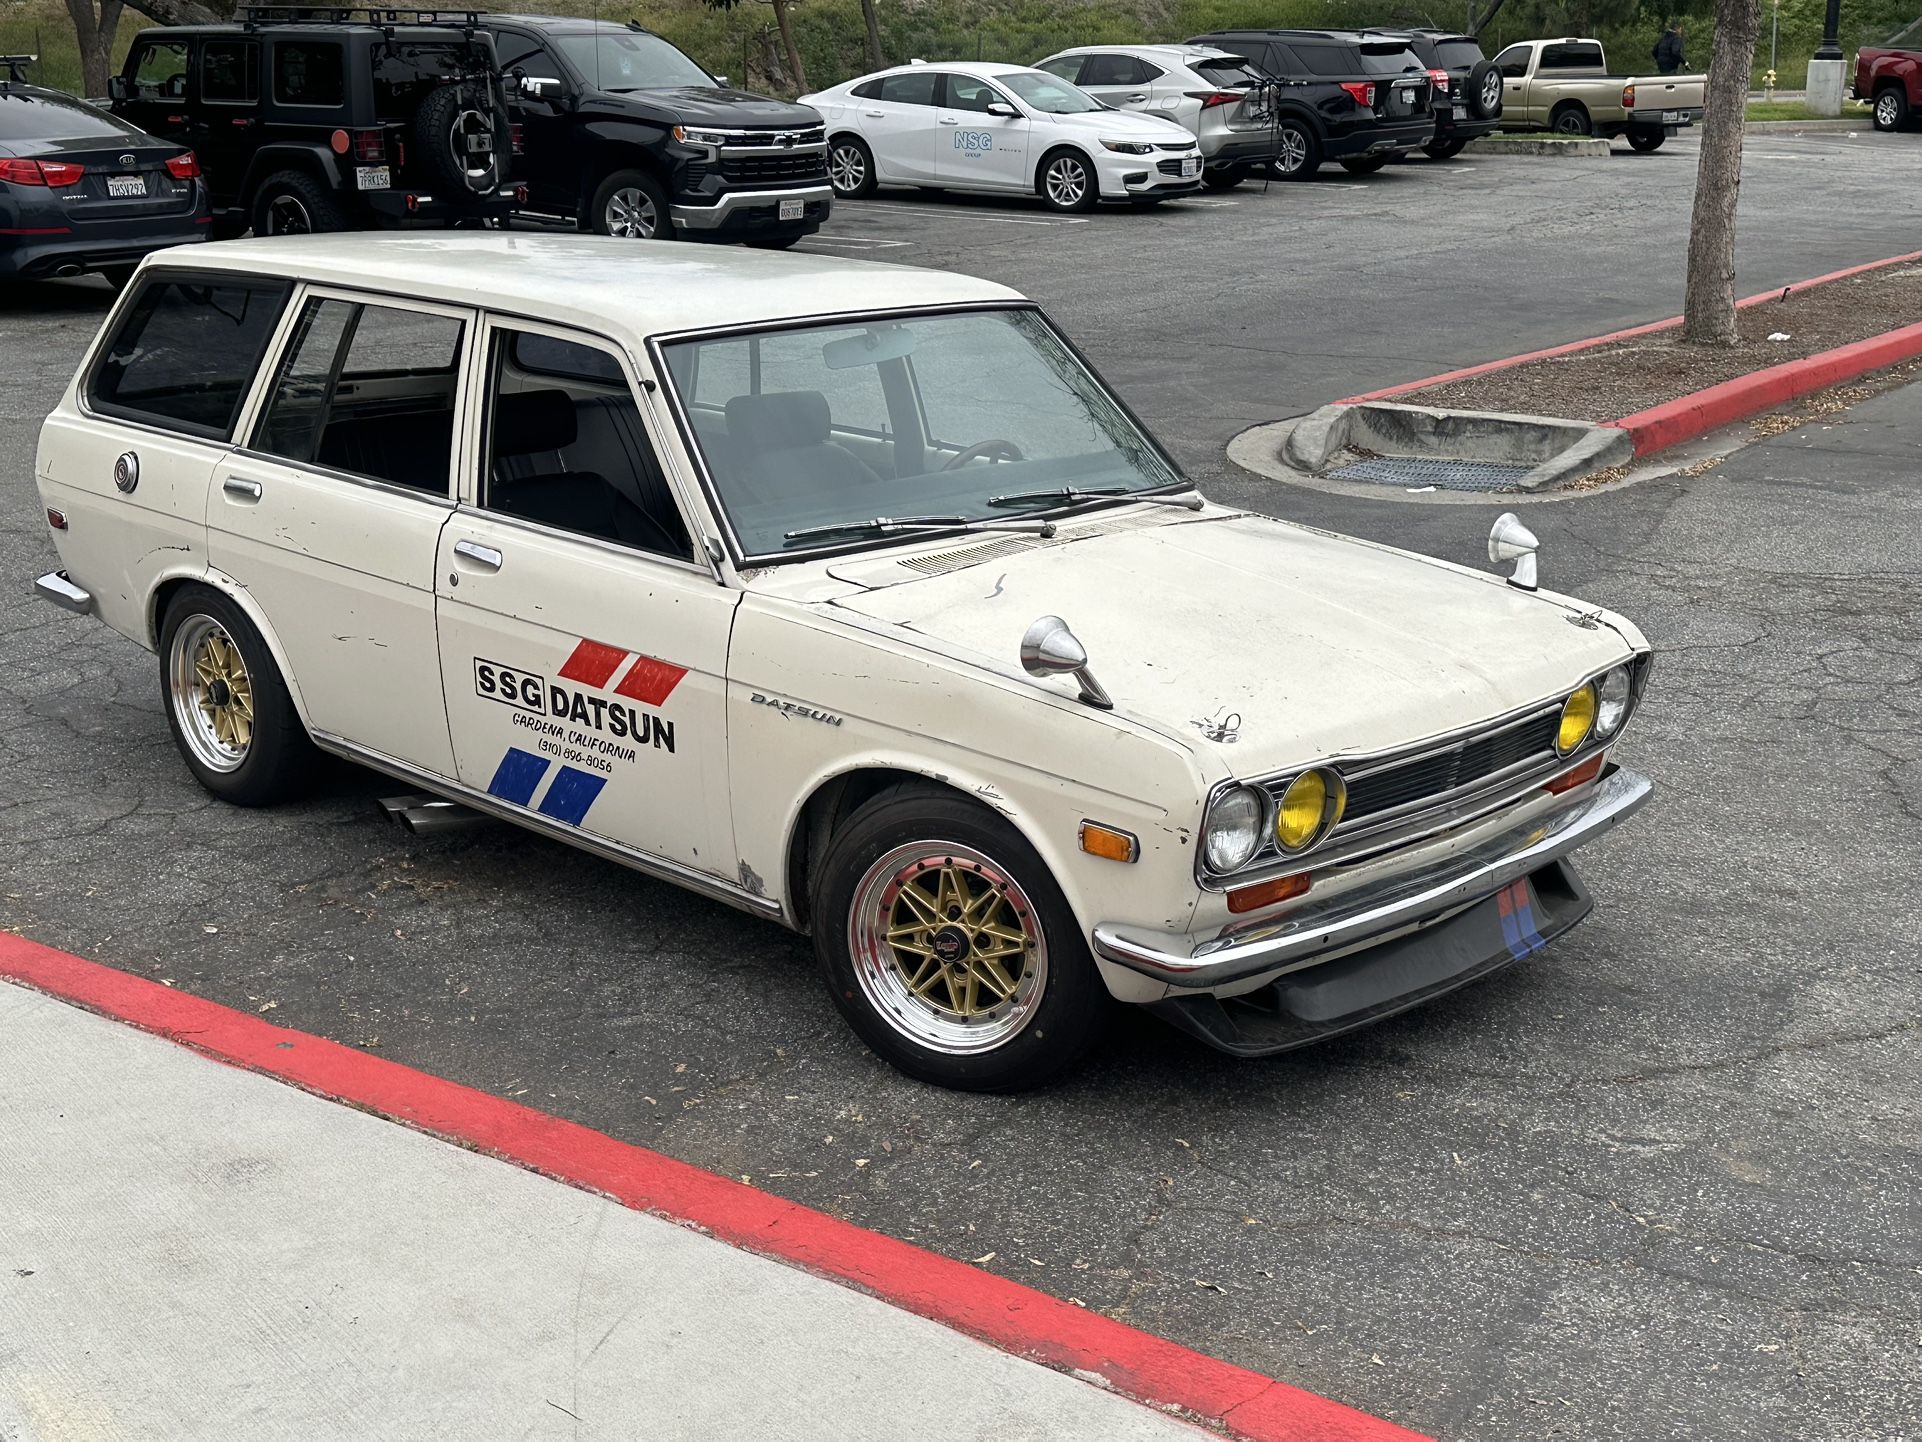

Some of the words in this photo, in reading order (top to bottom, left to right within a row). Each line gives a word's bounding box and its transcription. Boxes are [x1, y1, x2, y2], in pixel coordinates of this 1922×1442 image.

[955, 131, 992, 150] NSG
[478, 664, 543, 709] SSG
[550, 685, 676, 753] DATSUN
[750, 692, 843, 727] DATSUN
[512, 713, 566, 742] GARDENA,
[568, 730, 636, 763] CALIFORNIA
[538, 738, 562, 757] (310)
[563, 748, 613, 773] 896-8056
